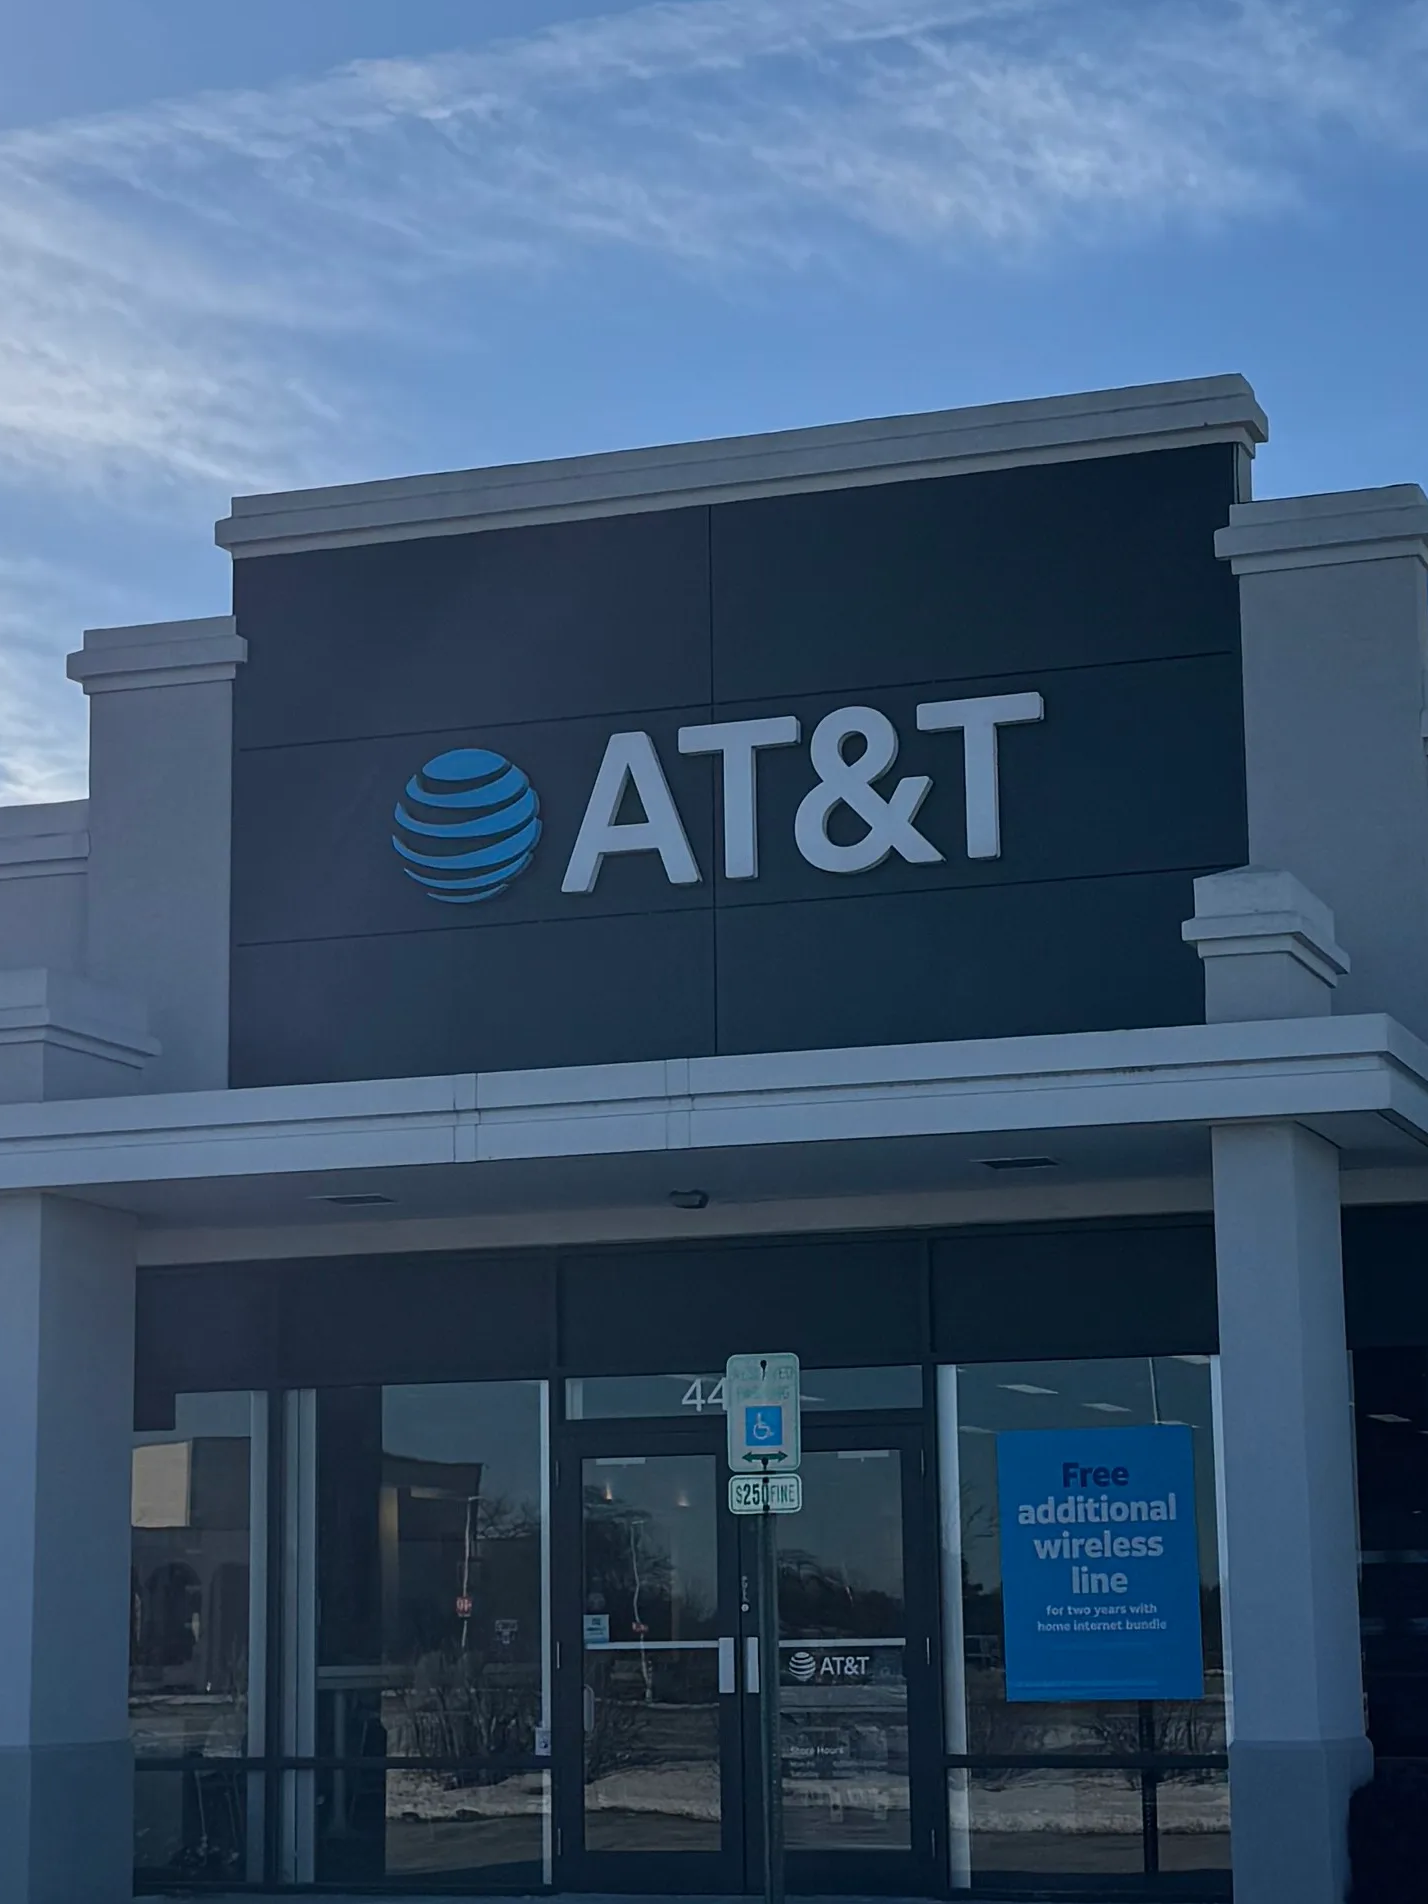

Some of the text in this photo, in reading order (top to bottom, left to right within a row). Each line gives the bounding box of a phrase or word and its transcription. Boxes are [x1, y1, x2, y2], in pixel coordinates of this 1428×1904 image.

[561, 692, 1044, 893] AT&T
[1062, 1462, 1130, 1488] Free
[736, 1483, 796, 1506] $250 FINE
[1018, 1493, 1177, 1524] additional
[1033, 1530, 1164, 1559] wireless
[1072, 1566, 1129, 1594] line
[1046, 1603, 1158, 1618] for two years with
[1037, 1618, 1167, 1632] home internet bundle
[819, 1656, 870, 1675] AT&T
